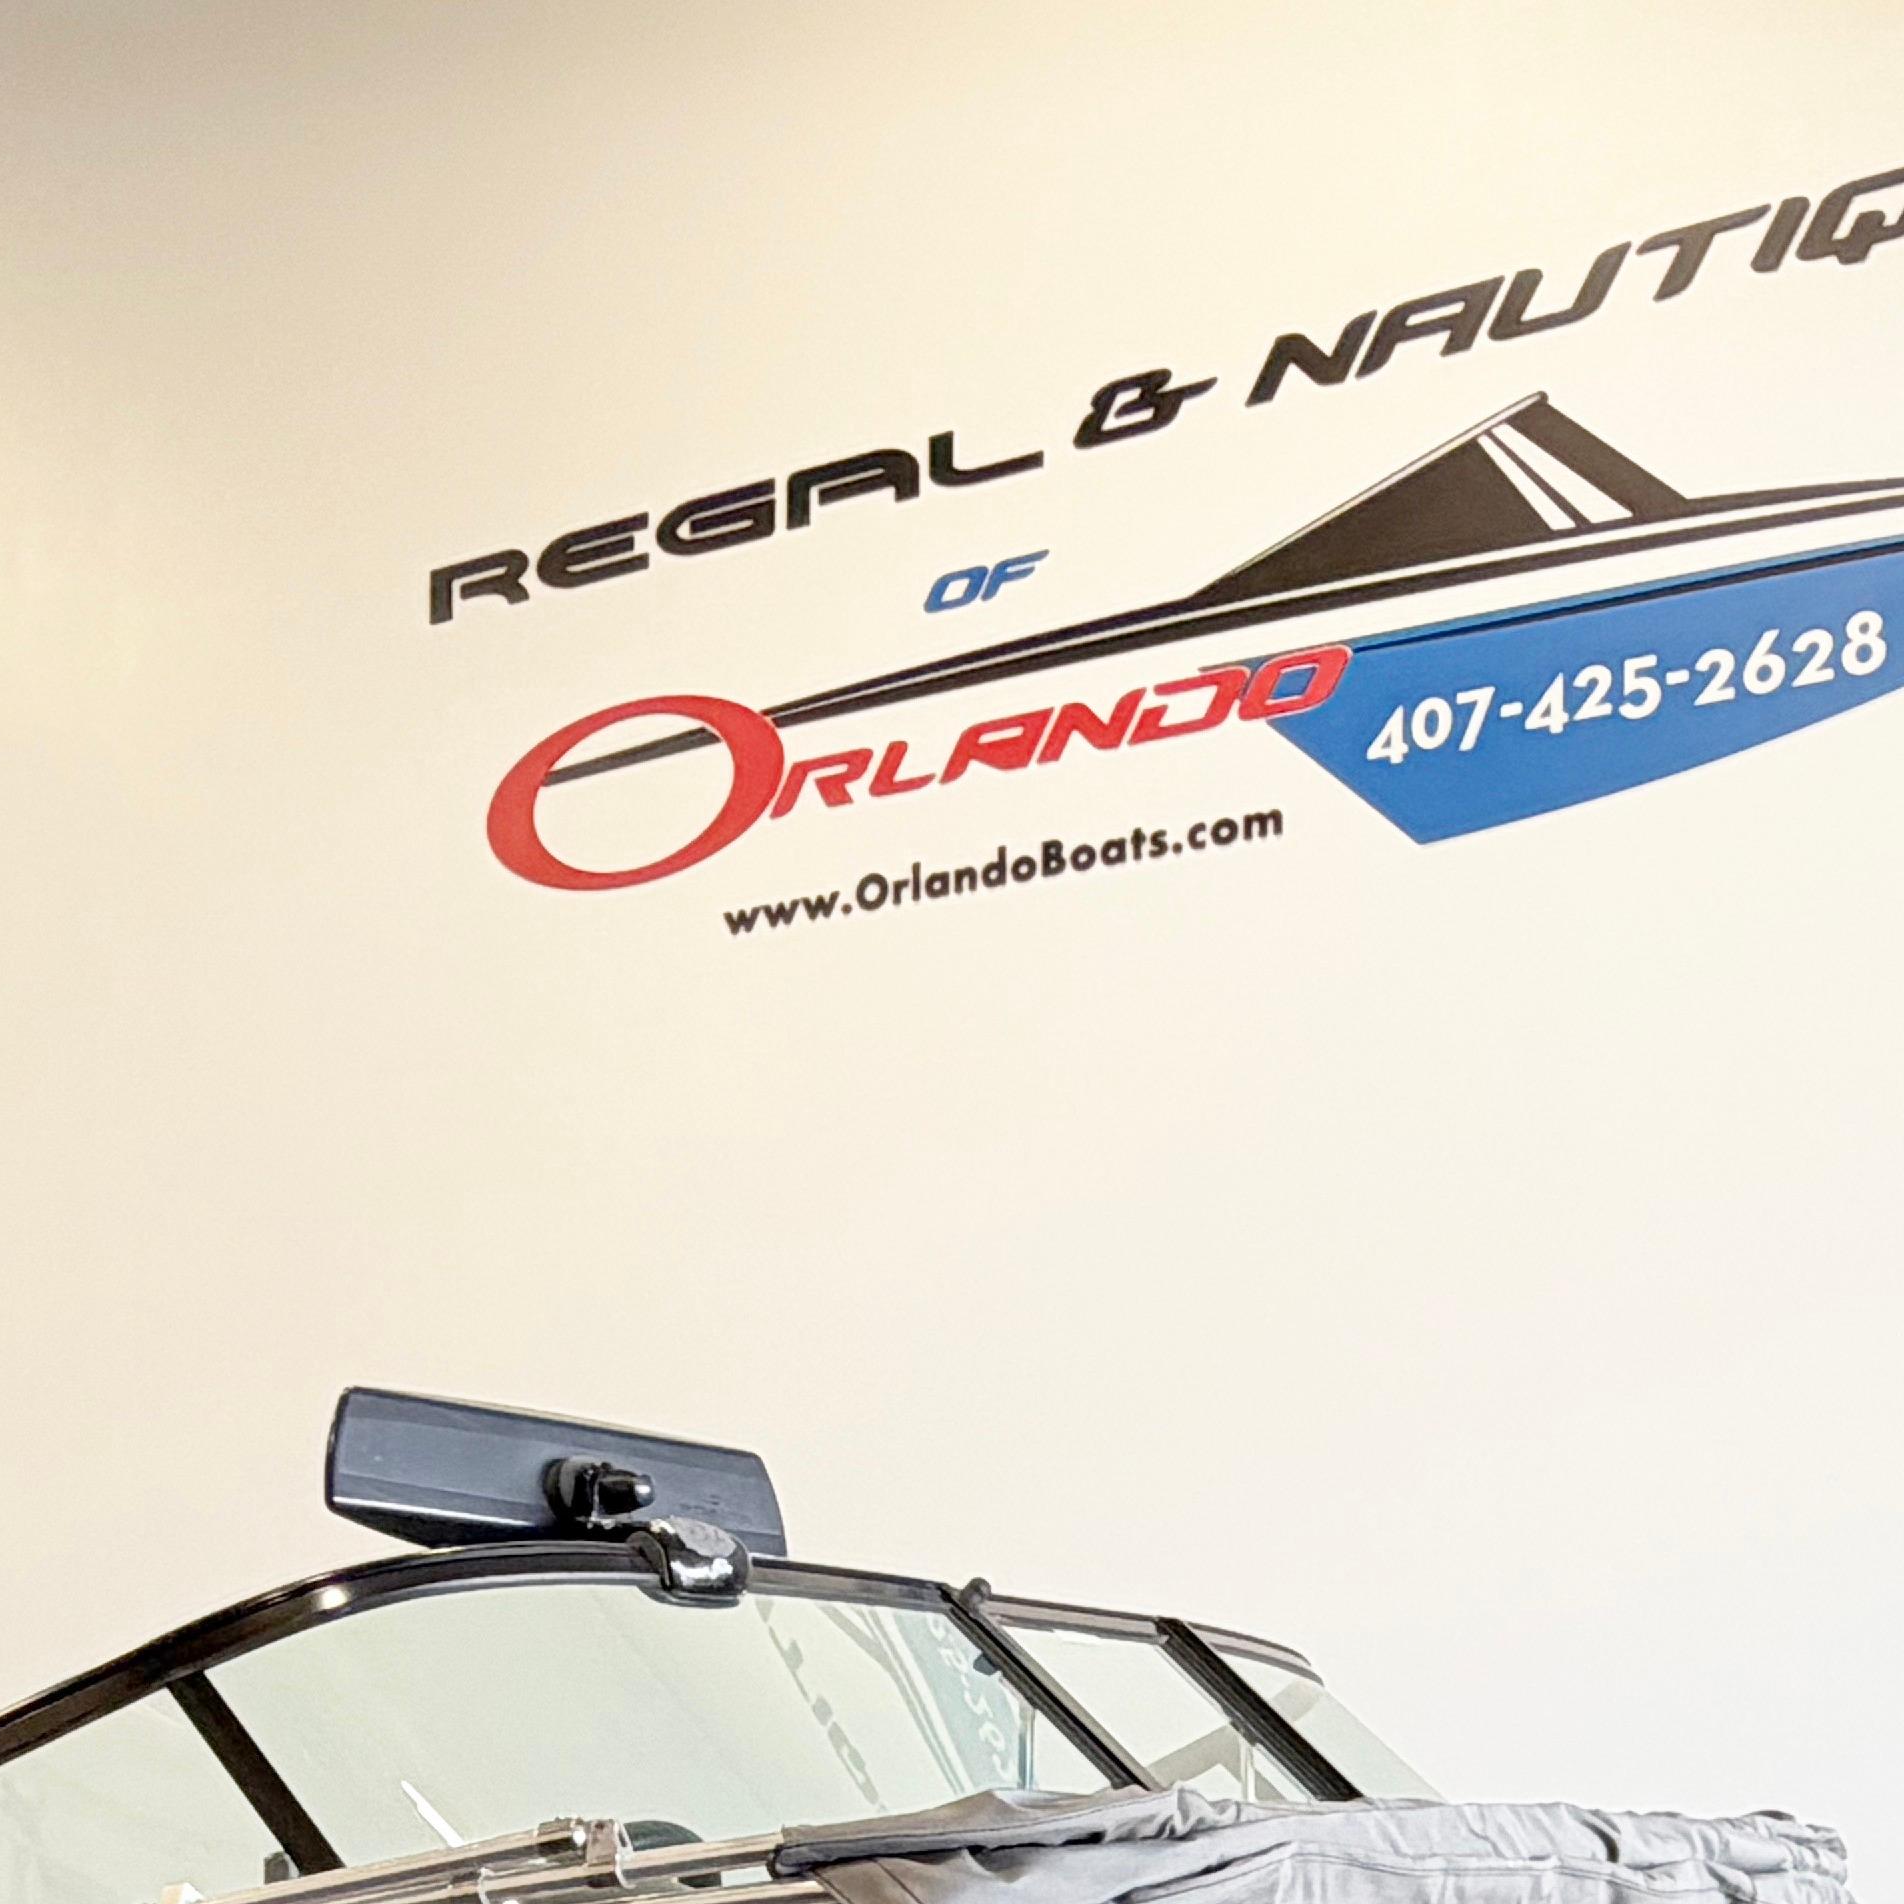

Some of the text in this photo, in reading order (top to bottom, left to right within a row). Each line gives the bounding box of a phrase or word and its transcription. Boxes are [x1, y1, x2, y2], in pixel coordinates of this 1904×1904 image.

[430, 403, 1045, 625] REGAL
[1073, 367, 1218, 449] &
[924, 549, 1050, 613] OF
[1365, 609, 1889, 765] 407-425-2628
[487, 648, 1350, 891] ORLANDO
[724, 819, 1284, 936] www.OrlandoBoats.com
